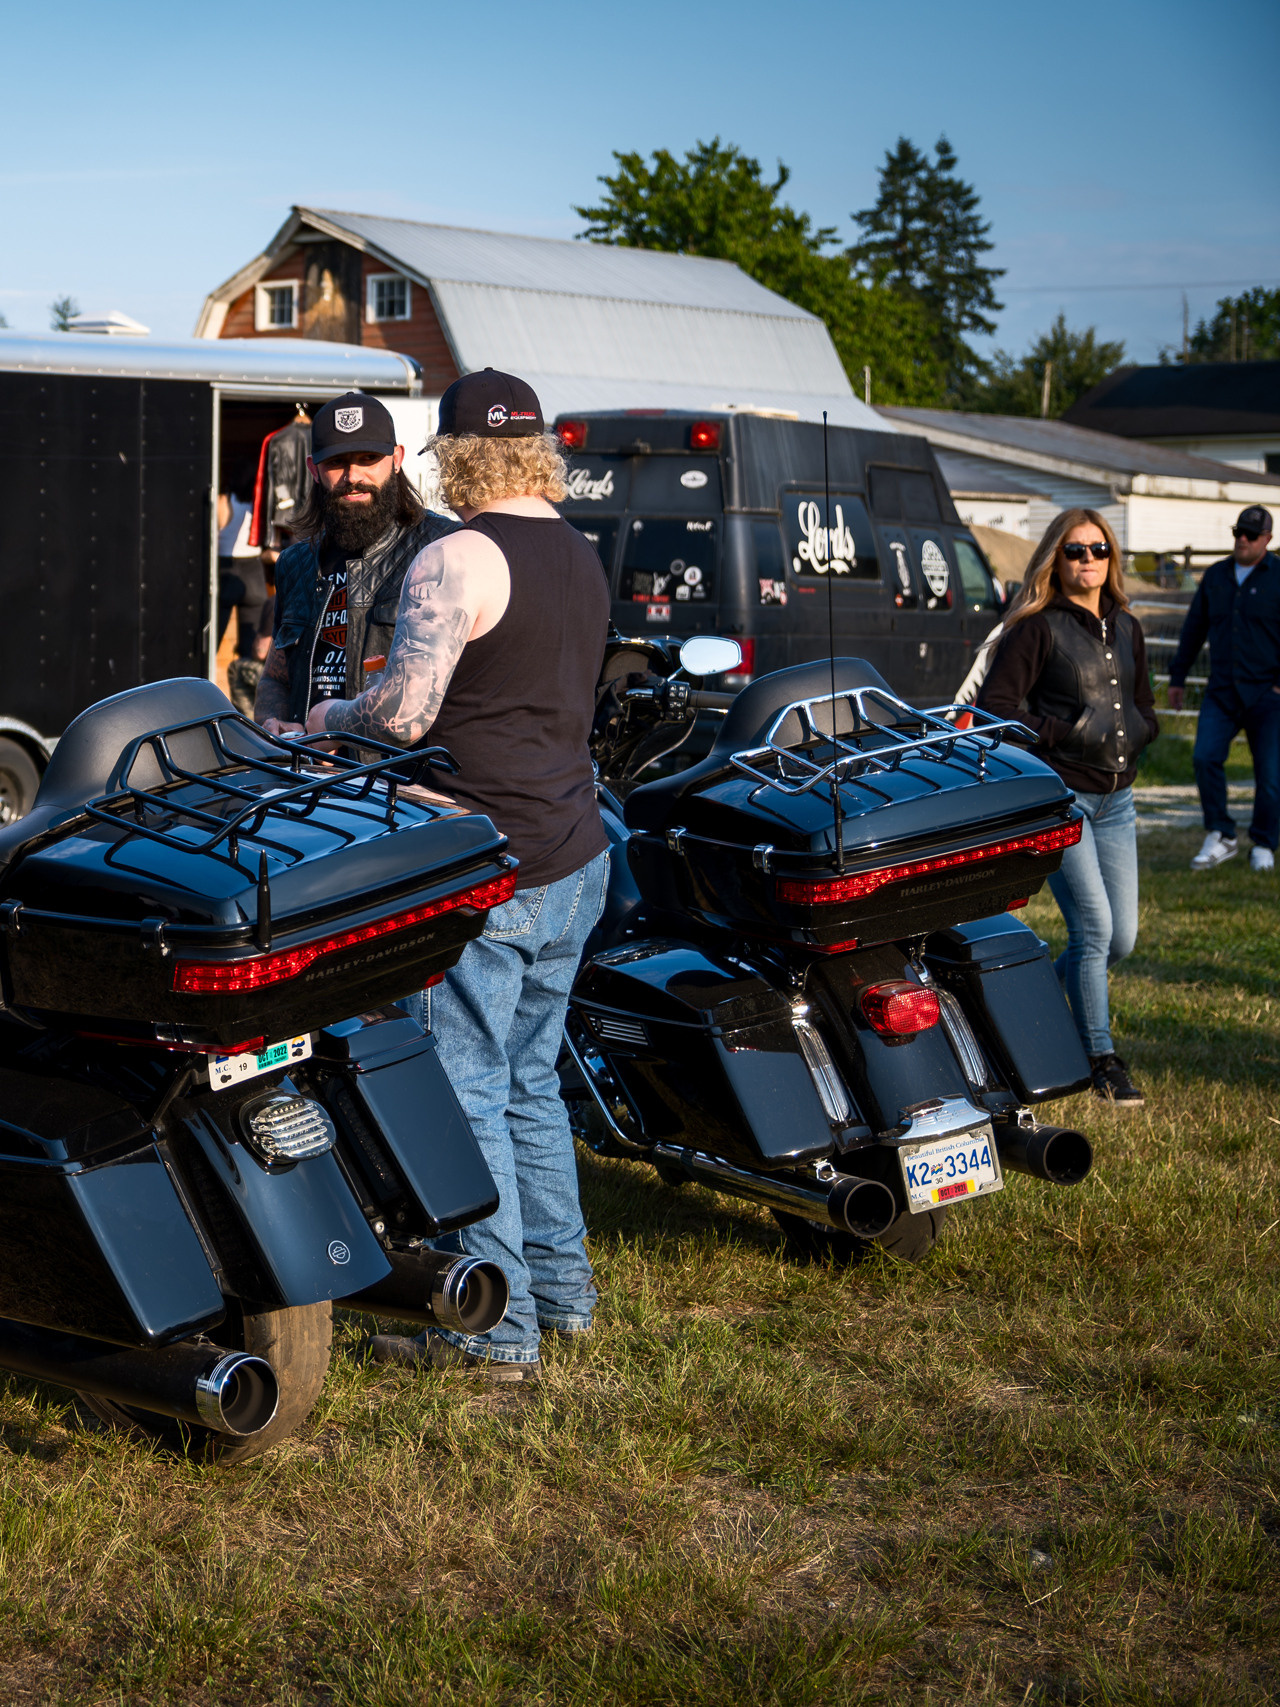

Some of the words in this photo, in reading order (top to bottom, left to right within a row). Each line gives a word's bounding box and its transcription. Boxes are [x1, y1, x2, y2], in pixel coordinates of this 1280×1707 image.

[487, 411, 508, 421] ML
[568, 468, 615, 500] Lords
[798, 501, 856, 575] Lords
[900, 868, 997, 898] HARLEY-DAVIDSON
[305, 932, 436, 982] HARLEY-DAVIDSON
[274, 1045, 287, 1058] 2022
[215, 1064, 231, 1075] M.C.
[238, 1062, 248, 1072] 19
[907, 1149, 935, 1161] Beautiful
[935, 1143, 955, 1154] British
[955, 1137, 985, 1149] Columbia
[906, 1162, 932, 1189] K2
[944, 1145, 991, 1178] 3344
[935, 1177, 944, 1185] 30
[911, 1192, 926, 1200] M.C.
[940, 1187, 951, 1197] OCT
